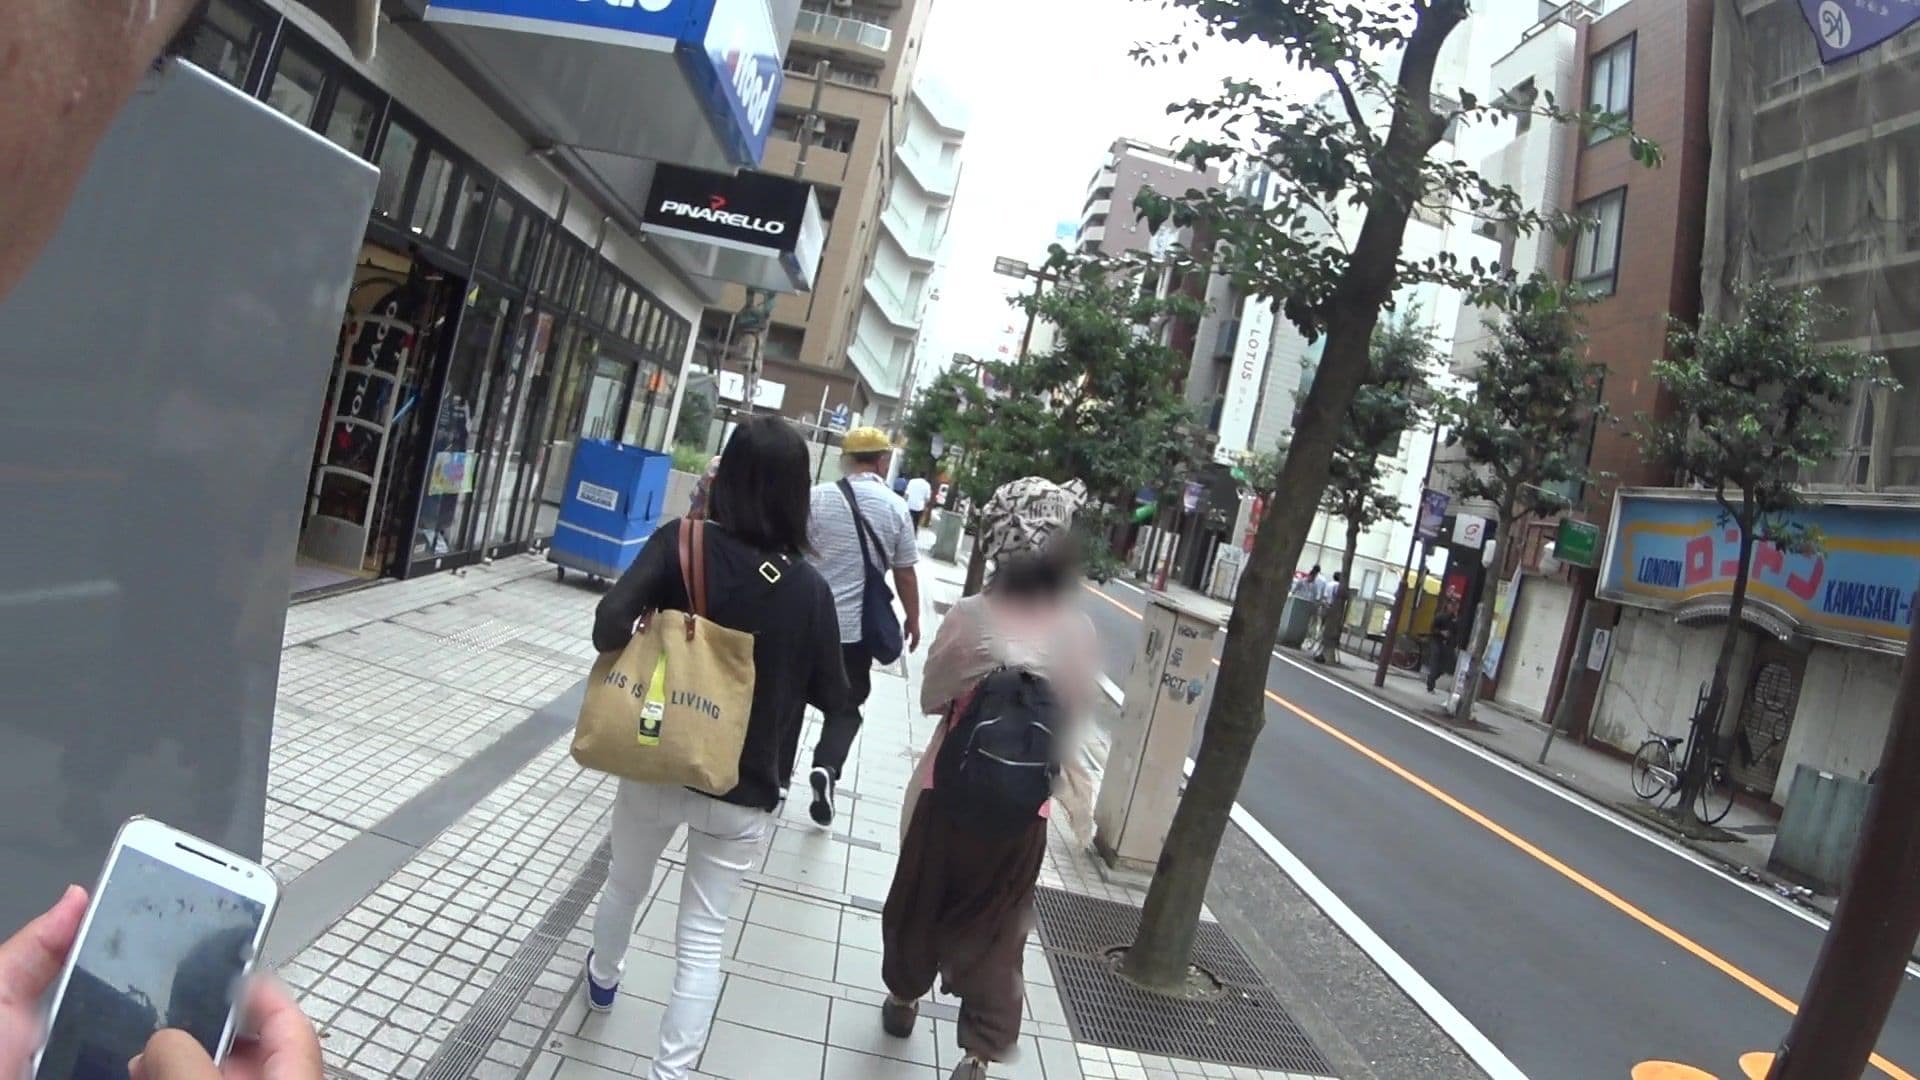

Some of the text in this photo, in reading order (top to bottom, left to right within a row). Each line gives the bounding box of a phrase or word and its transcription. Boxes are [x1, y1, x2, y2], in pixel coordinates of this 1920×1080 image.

[660, 200, 785, 234] PINARELLO
[1241, 330, 1262, 382] LOTUS
[1637, 556, 1683, 588] LONDON
[630, 683, 643, 699] IS
[671, 690, 720, 720] LIVING
